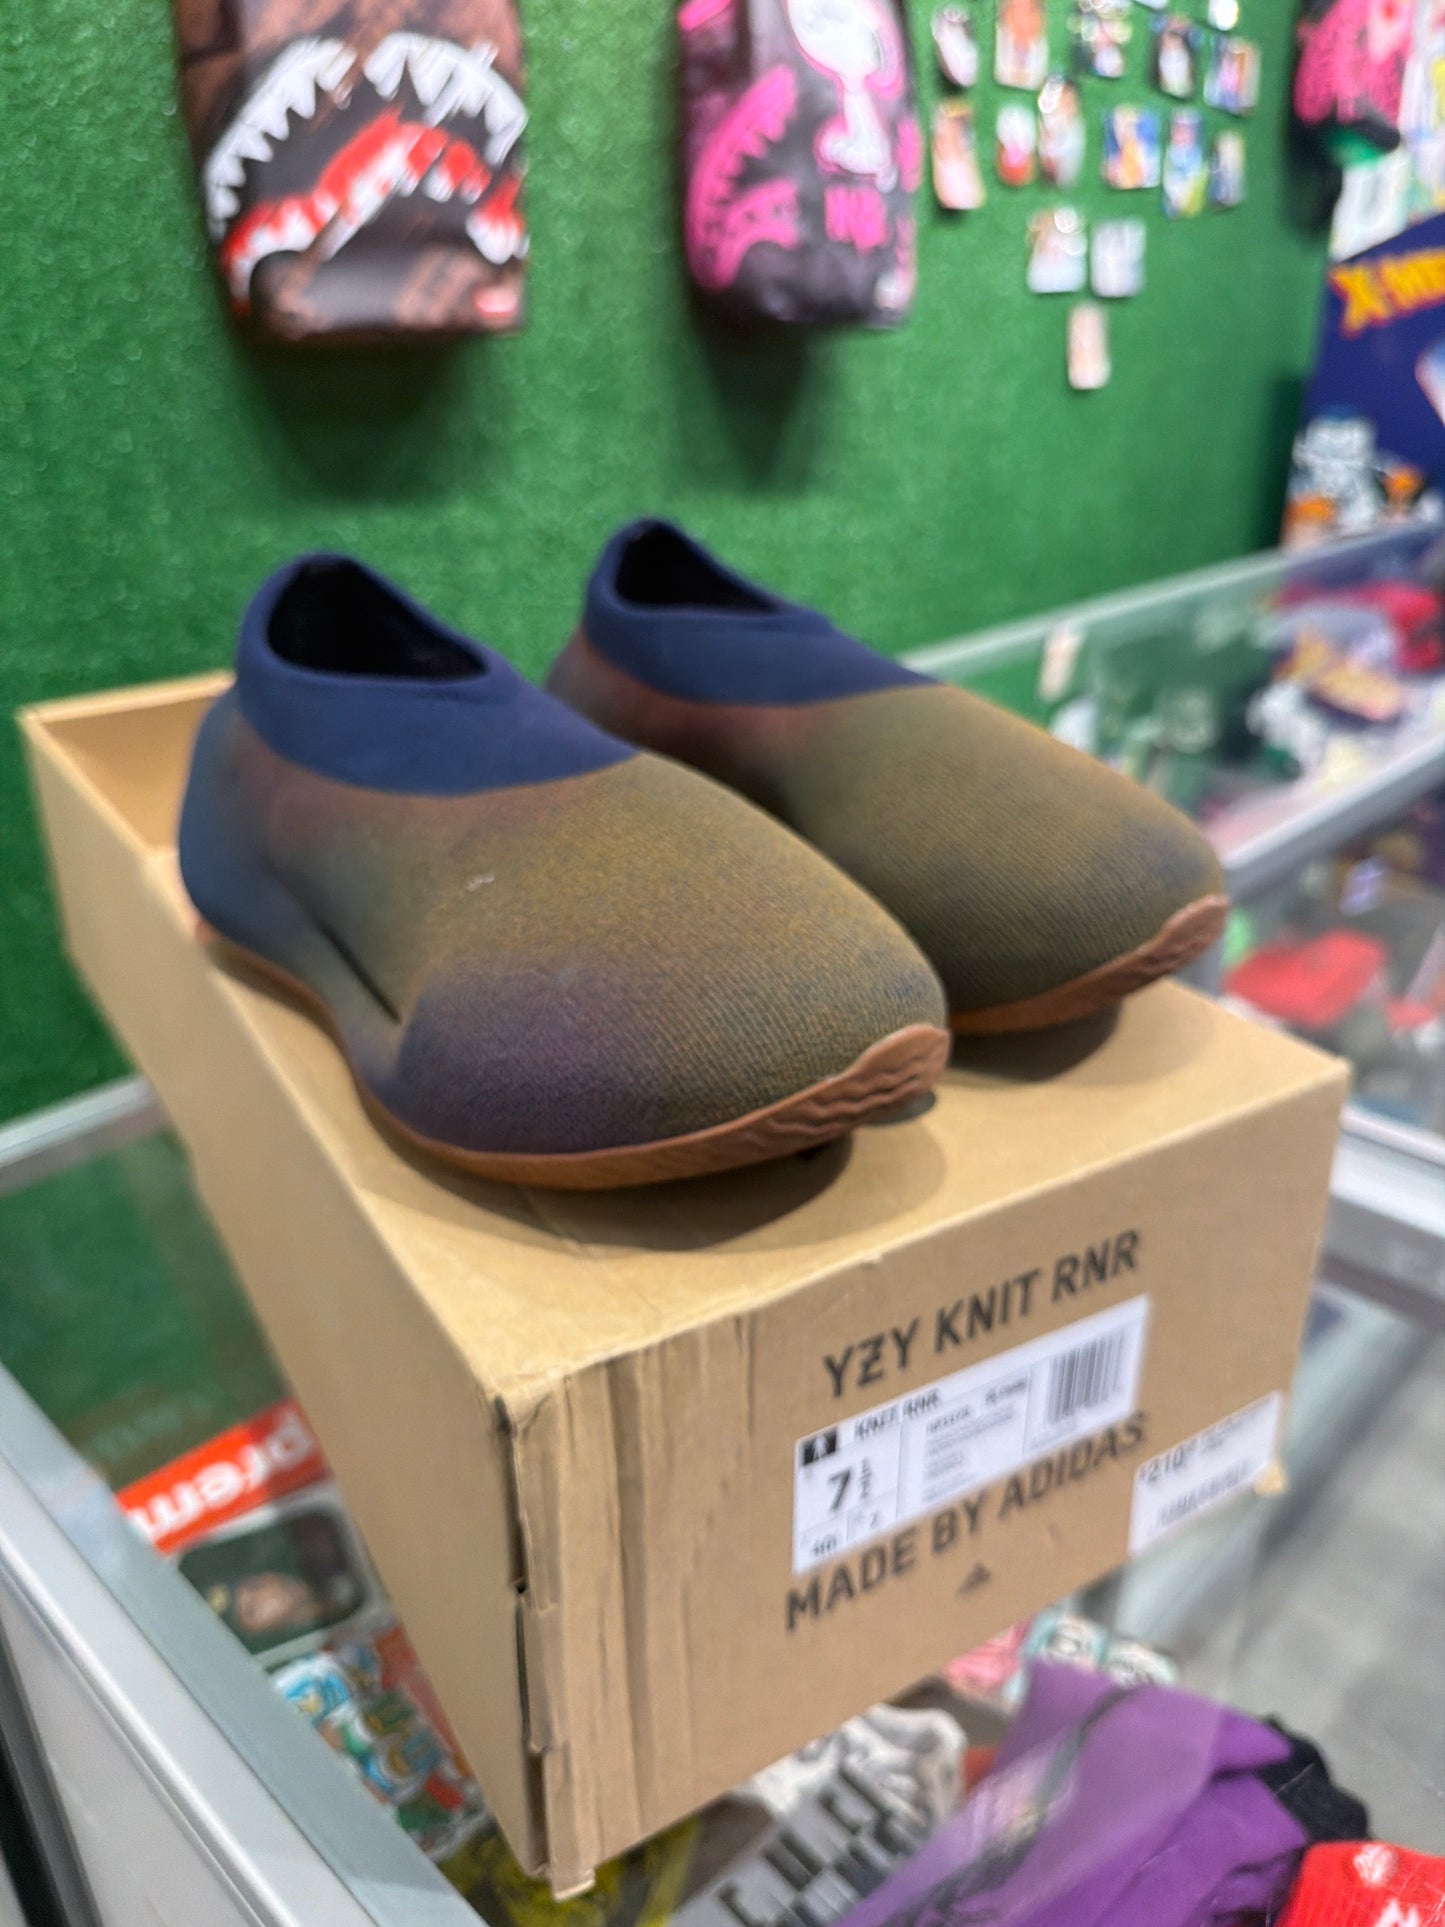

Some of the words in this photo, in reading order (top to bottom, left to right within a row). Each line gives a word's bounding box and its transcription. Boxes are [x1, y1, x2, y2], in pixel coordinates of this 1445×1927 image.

[823, 1317, 920, 1398] YZY
[934, 1268, 1041, 1353] KNIT
[1052, 1228, 1141, 1301] RNR
[785, 1526, 920, 1632] MADE
[931, 1488, 989, 1557] BY
[997, 1411, 1146, 1520] ADIDAS
